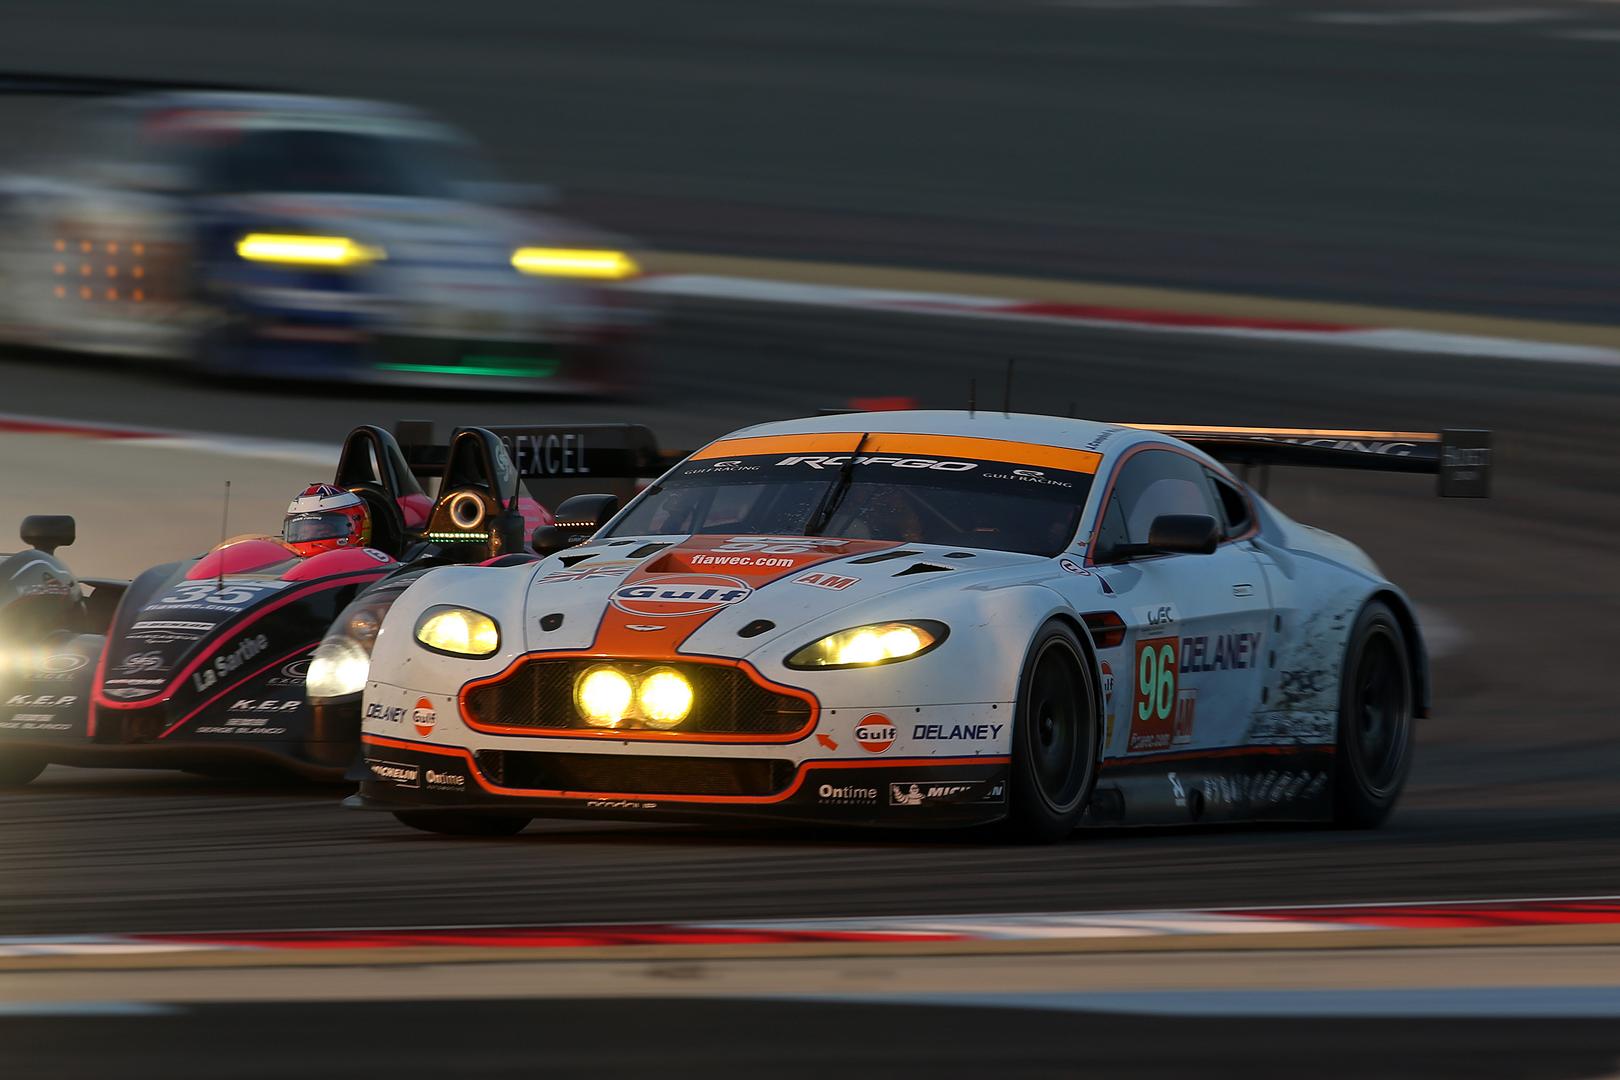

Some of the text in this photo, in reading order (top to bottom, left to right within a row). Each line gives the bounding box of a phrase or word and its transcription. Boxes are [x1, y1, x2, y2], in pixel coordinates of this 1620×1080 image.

[515, 434, 591, 475] EXCEL
[982, 472, 1072, 488] GULF RACING
[710, 542, 818, 554] 96
[691, 554, 794, 568] fiawec.com
[794, 574, 857, 589] AM
[160, 584, 264, 604] 35
[616, 586, 748, 601] Gulf
[1147, 606, 1173, 625] WEC
[1180, 632, 1261, 673] DELANEY
[192, 633, 269, 693] La Sarthe
[1137, 643, 1175, 721] 96
[366, 703, 408, 723] DELANEY
[855, 727, 897, 740] Gulf
[912, 724, 1004, 740] DELANEY
[818, 784, 878, 799] Ontime
